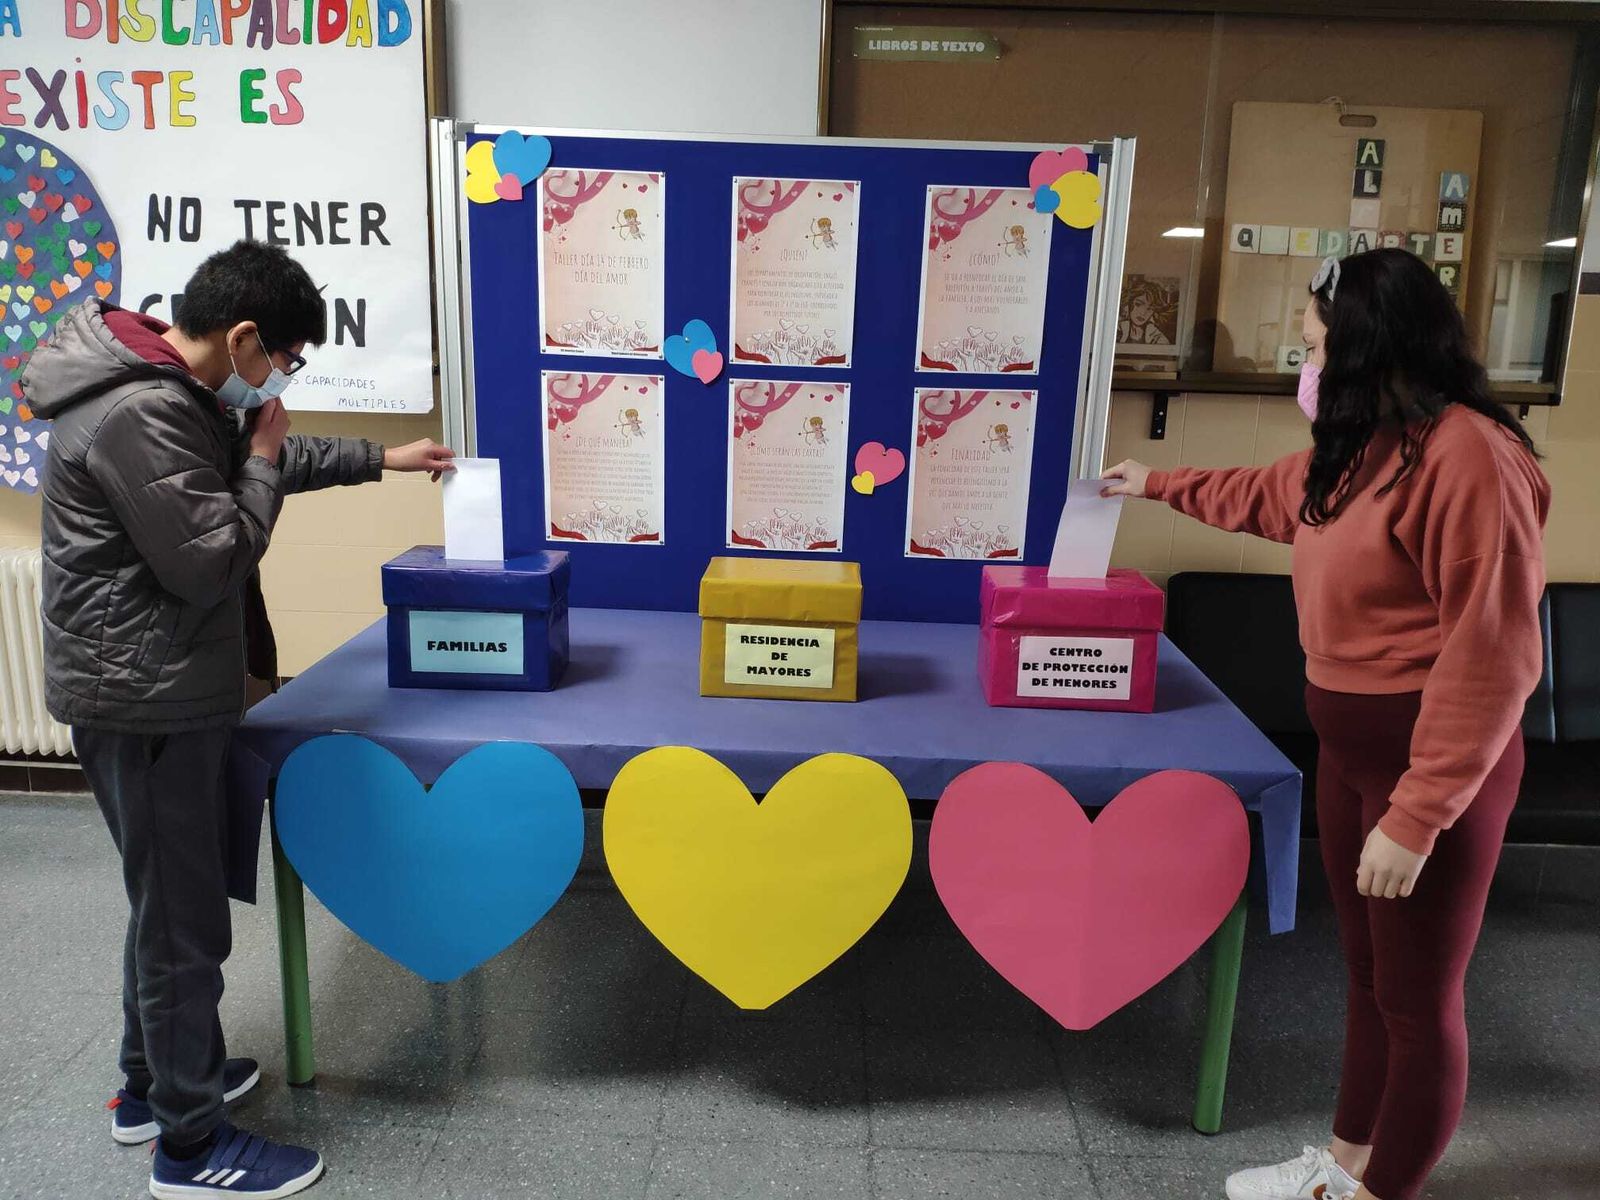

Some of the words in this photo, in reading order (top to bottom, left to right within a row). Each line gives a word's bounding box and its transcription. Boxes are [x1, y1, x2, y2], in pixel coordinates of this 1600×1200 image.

[868, 39, 918, 51] LIBROS
[921, 41, 939, 52] DE
[941, 41, 985, 53] TEXTO
[240, 68, 304, 125] ES
[147, 193, 202, 243] NO
[234, 199, 391, 246] TENER
[305, 376, 376, 391] CAPACIDADES
[338, 399, 407, 410] MULTIPLES
[427, 640, 508, 653] FAMILIAS
[740, 635, 820, 648] RESIDENCIA
[771, 652, 788, 661] DE
[1049, 647, 1102, 658] CENTRO
[746, 666, 811, 677] MAYORES
[1022, 663, 1039, 671] DE
[1032, 678, 1048, 687] DE
[1053, 678, 1117, 689] MENORES
